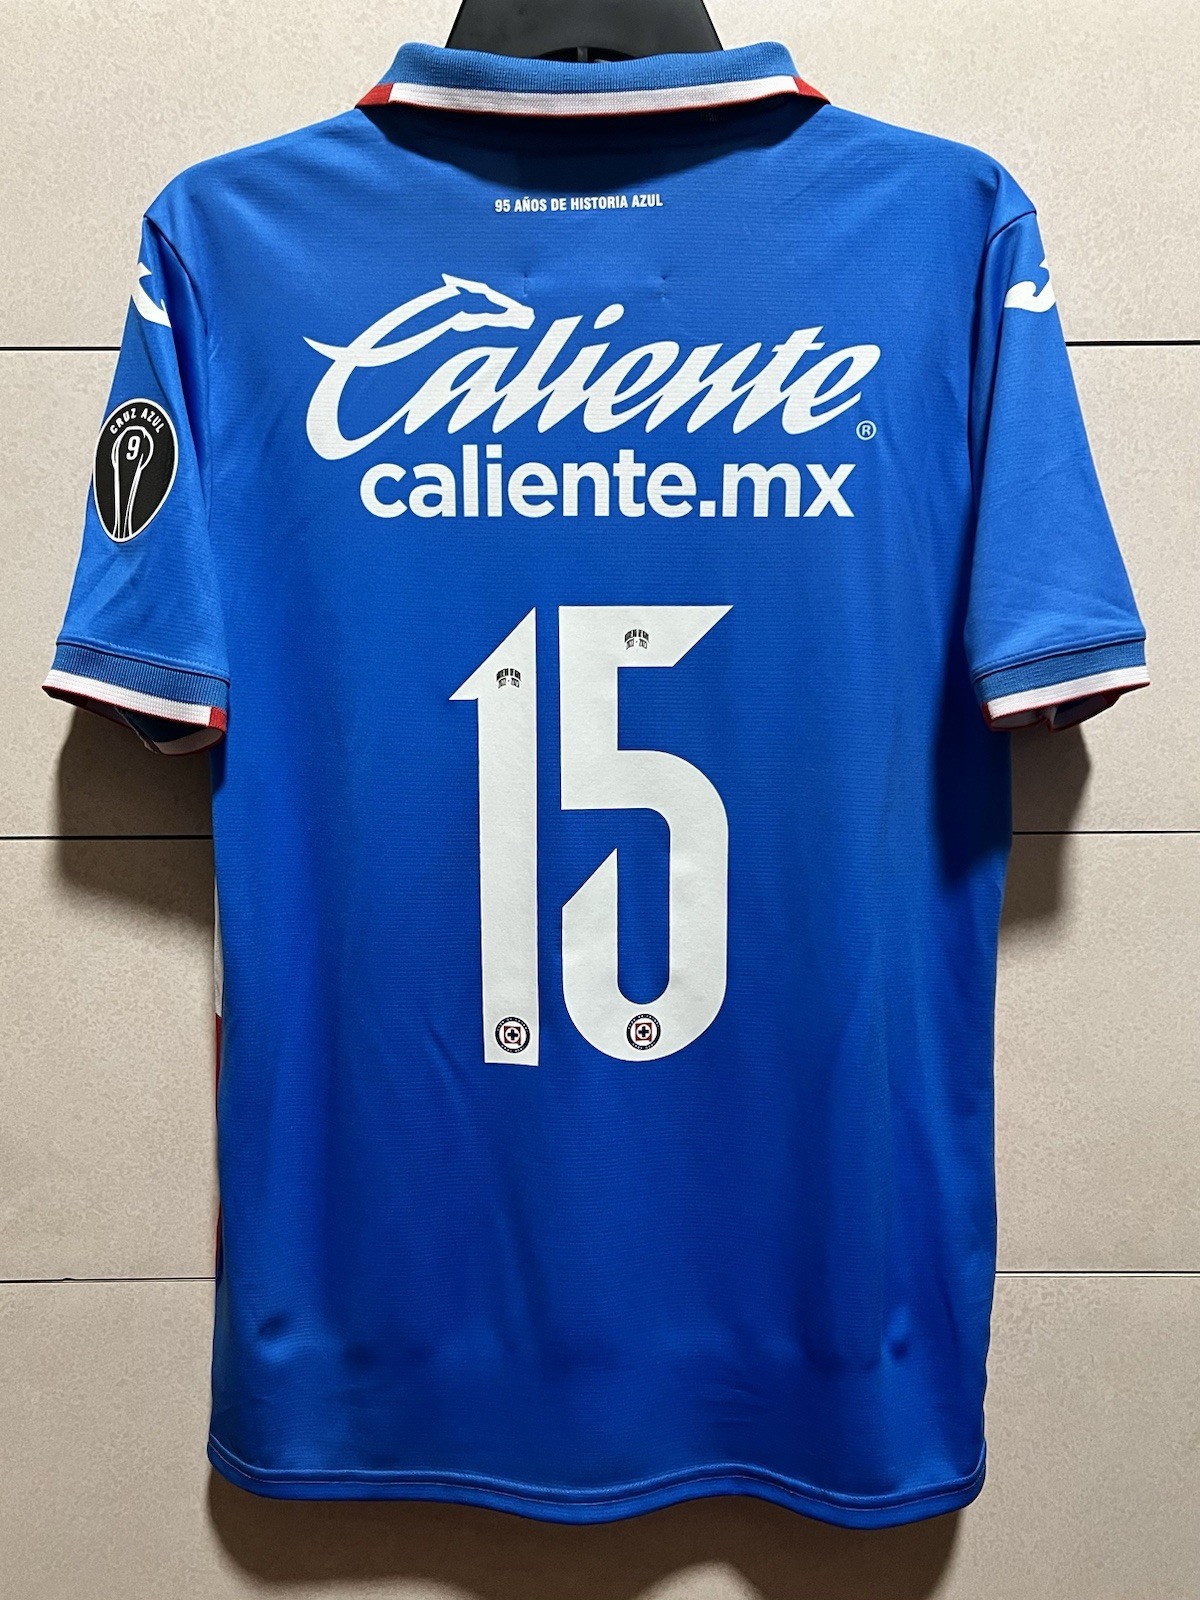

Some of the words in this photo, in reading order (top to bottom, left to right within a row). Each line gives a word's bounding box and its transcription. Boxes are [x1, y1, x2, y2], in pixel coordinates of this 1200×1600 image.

[494, 199, 510, 213] 95
[514, 196, 547, 212] AÑOS
[550, 198, 567, 212] DE
[570, 195, 628, 211] HISTORIA
[631, 194, 663, 208] AZUL
[303, 273, 881, 461] Caliente
[109, 407, 137, 435] CRUZ
[140, 407, 165, 434] AZUL
[126, 435, 141, 461] 9
[360, 444, 855, 518] caliente.mx
[448, 604, 734, 1067] 15
